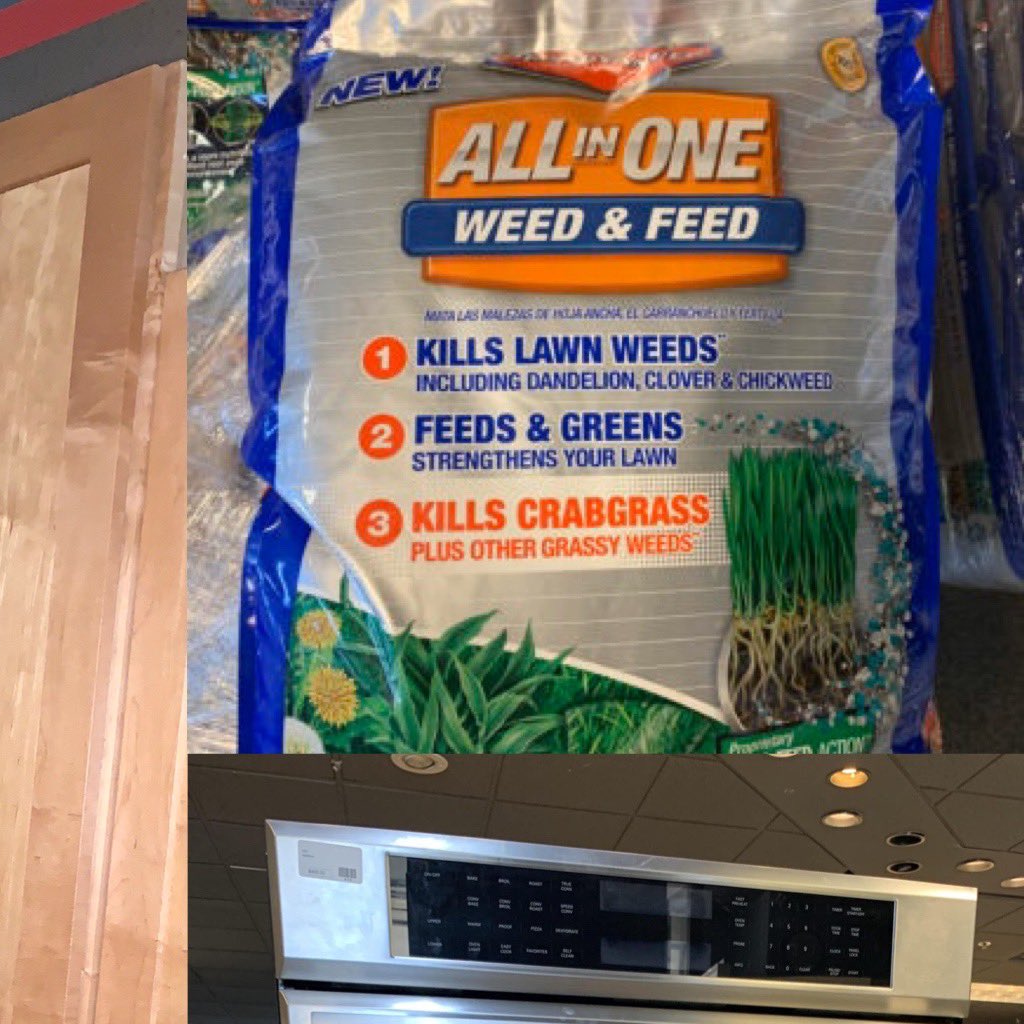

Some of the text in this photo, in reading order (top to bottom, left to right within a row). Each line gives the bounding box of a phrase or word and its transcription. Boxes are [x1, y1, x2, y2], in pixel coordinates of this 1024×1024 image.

[321, 64, 442, 105] NEW!
[437, 116, 768, 185] ALL IN ONE
[454, 206, 760, 243] WEED & FEED
[377, 345, 390, 371] 1
[416, 334, 720, 366] KILLS LAWN WEEDS
[416, 370, 833, 392] INCLUDING DANDELION, CLOVER & CHICKWEED
[370, 423, 393, 449] 2
[414, 411, 684, 444] FEEDS & GREENS
[412, 448, 677, 472] STRENGTHENS YOUR LAWN
[367, 510, 390, 538] 3
[412, 494, 711, 533] KILLS CRABGRASS
[411, 532, 694, 562] PLUS OTHER GRASSY WEEDS
